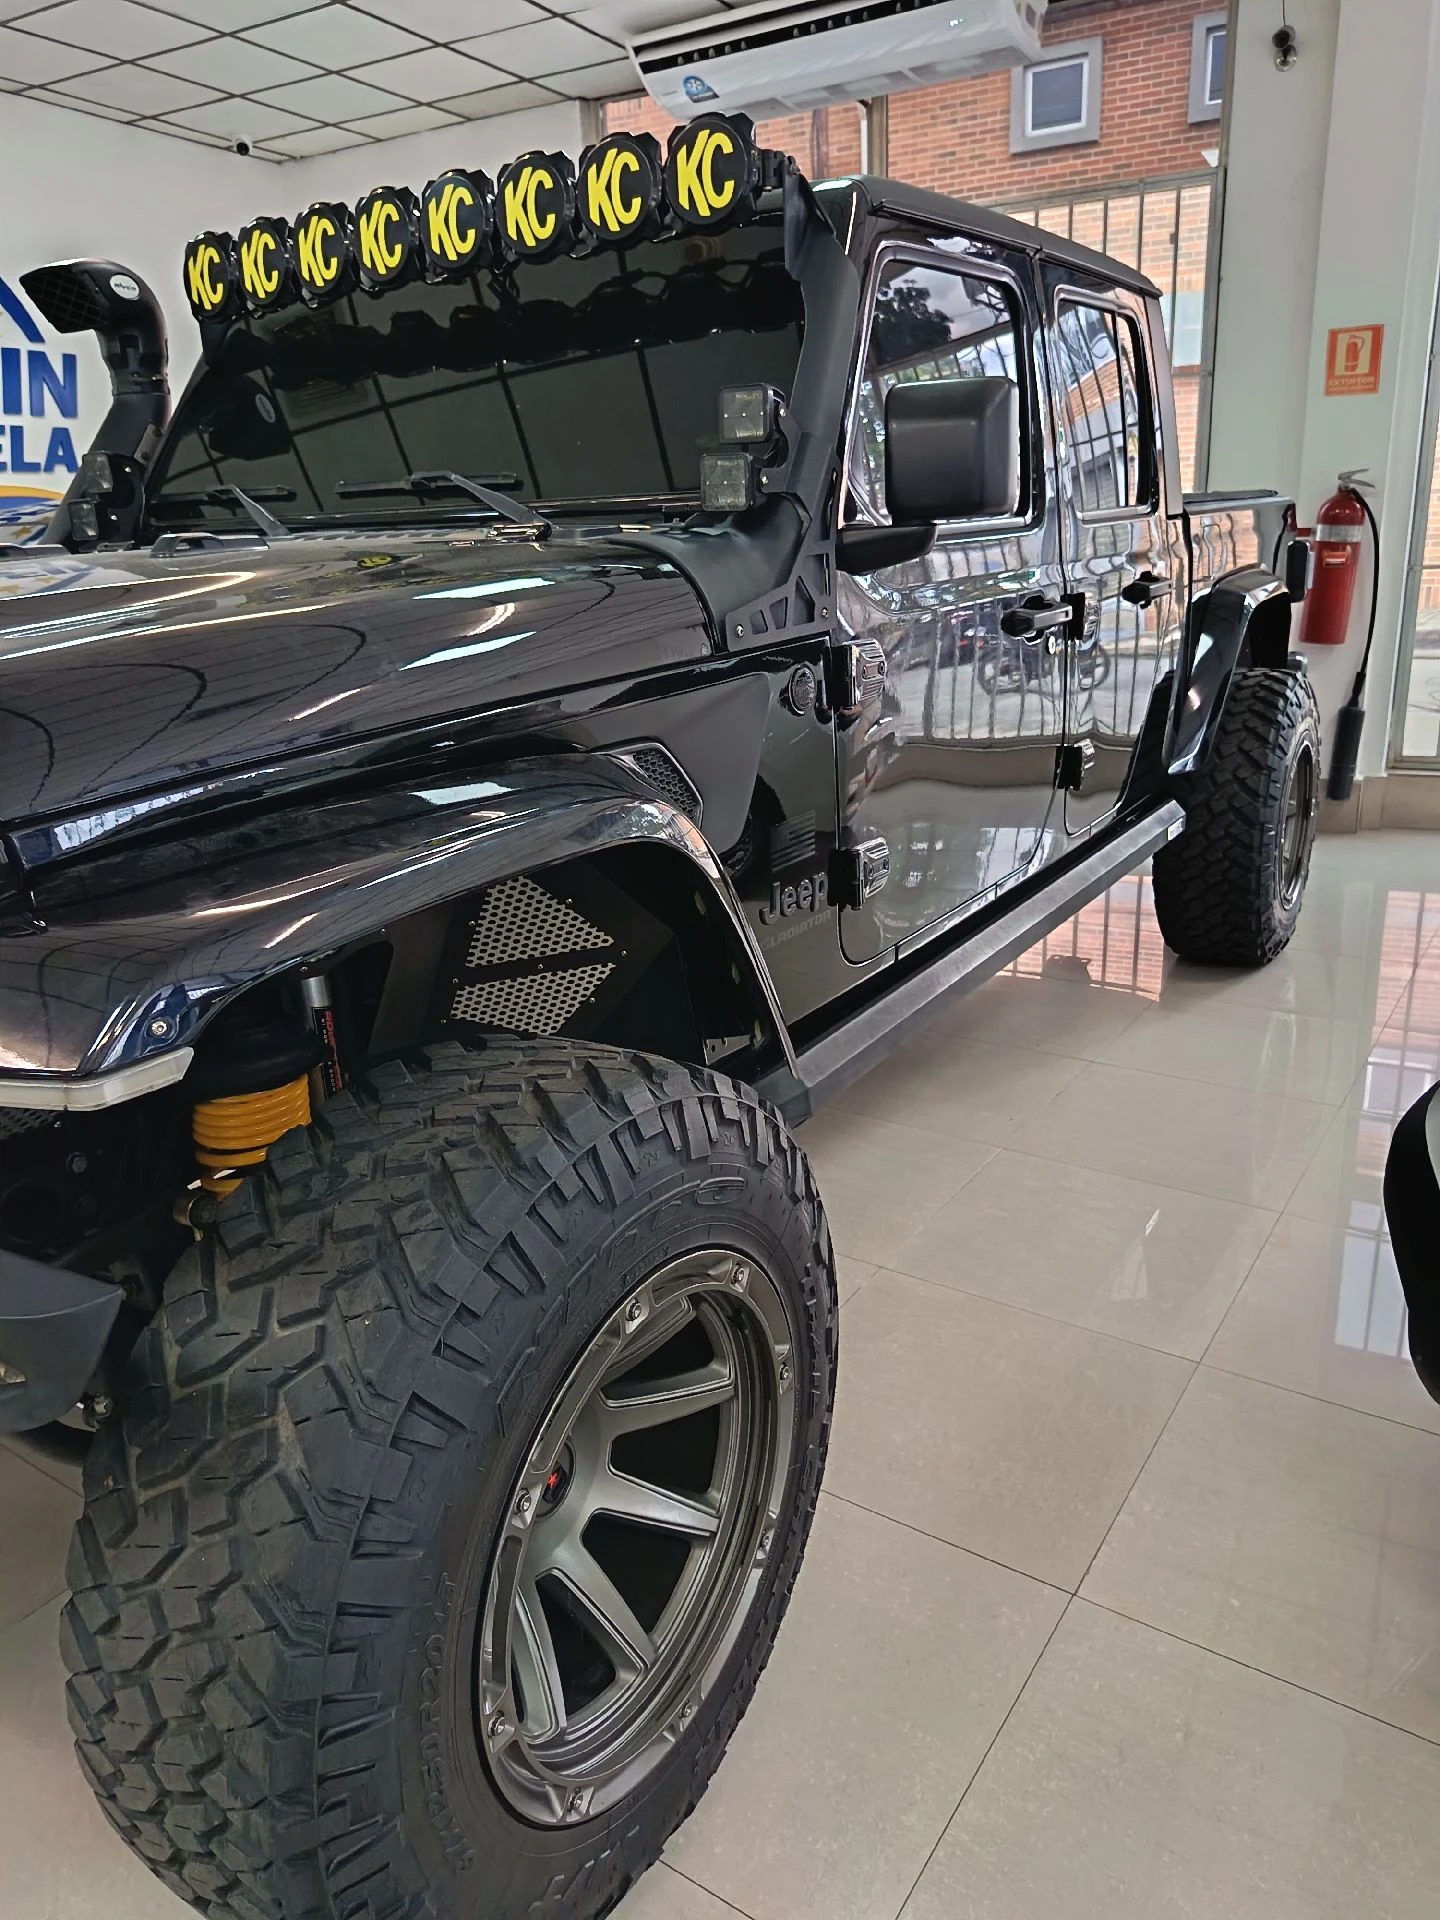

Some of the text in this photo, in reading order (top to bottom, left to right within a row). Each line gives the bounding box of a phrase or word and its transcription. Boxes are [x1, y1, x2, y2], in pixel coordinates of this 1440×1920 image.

[505, 168, 555, 245] KC
[588, 148, 641, 231] KC
[677, 131, 734, 216] KC
[299, 216, 337, 285] KC
[360, 201, 402, 274] KC
[428, 184, 475, 259] KC
[188, 245, 223, 310] KC
[241, 231, 278, 298] KC
[1328, 376, 1375, 385] EXTINTOR
[0, 424, 79, 473] LA
[759, 872, 828, 925] Jeep
[761, 909, 832, 951] GLADIATOR
